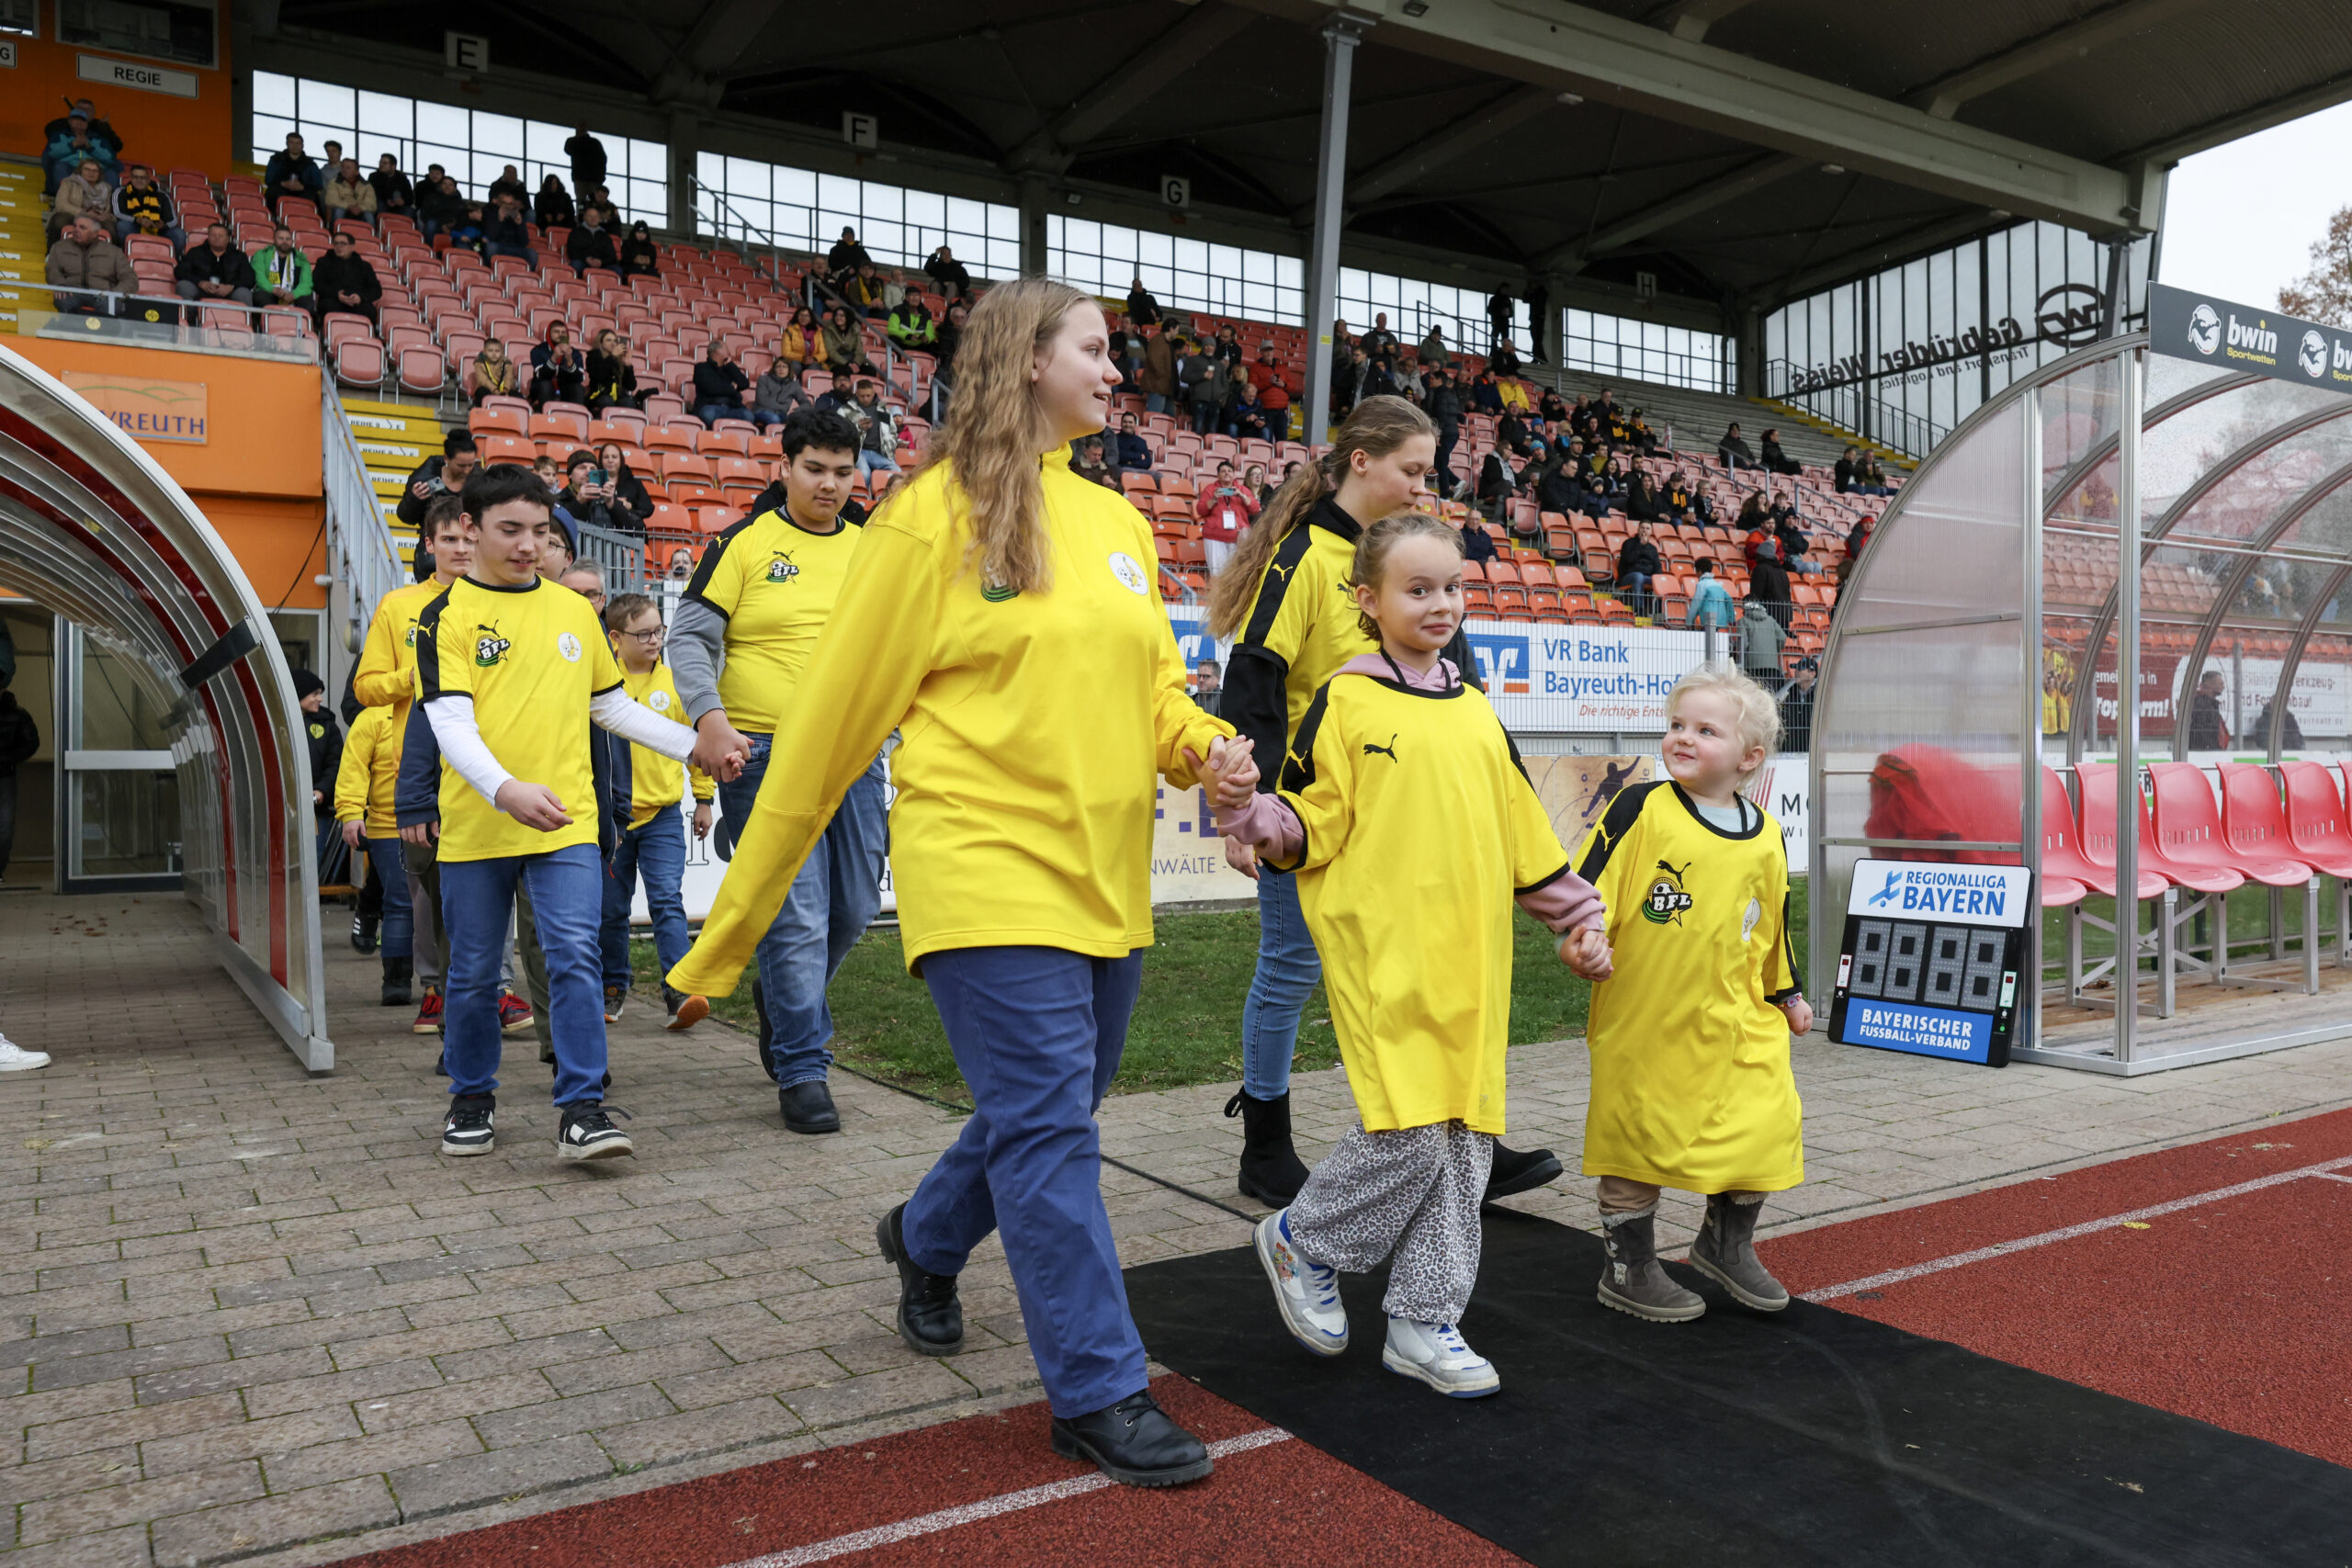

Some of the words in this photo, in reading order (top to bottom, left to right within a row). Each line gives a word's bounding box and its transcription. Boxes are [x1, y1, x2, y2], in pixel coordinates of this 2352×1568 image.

[457, 38, 478, 70] E
[114, 66, 162, 85] REGIE
[852, 117, 869, 143] F
[1168, 180, 1182, 204] G
[1641, 275, 1652, 296] H
[2227, 314, 2278, 354] bwin
[2227, 346, 2276, 366] Sportwetten
[350, 420, 372, 428] REIHE
[773, 565, 798, 577] BFL
[481, 639, 510, 660] BFL
[1543, 638, 1572, 661] VR
[1578, 640, 1629, 663] Bank
[1579, 705, 1598, 716] Die
[1600, 705, 1640, 719] richtige
[1642, 705, 1668, 717] Ents
[1905, 871, 2007, 889] REGIONALLIGA
[1653, 894, 1692, 911] BFL
[1902, 886, 2006, 916] BAYERN
[1861, 1008, 1973, 1038] BAYERISCHER
[1860, 1025, 1971, 1051] FUSSBALL-VERBAND
